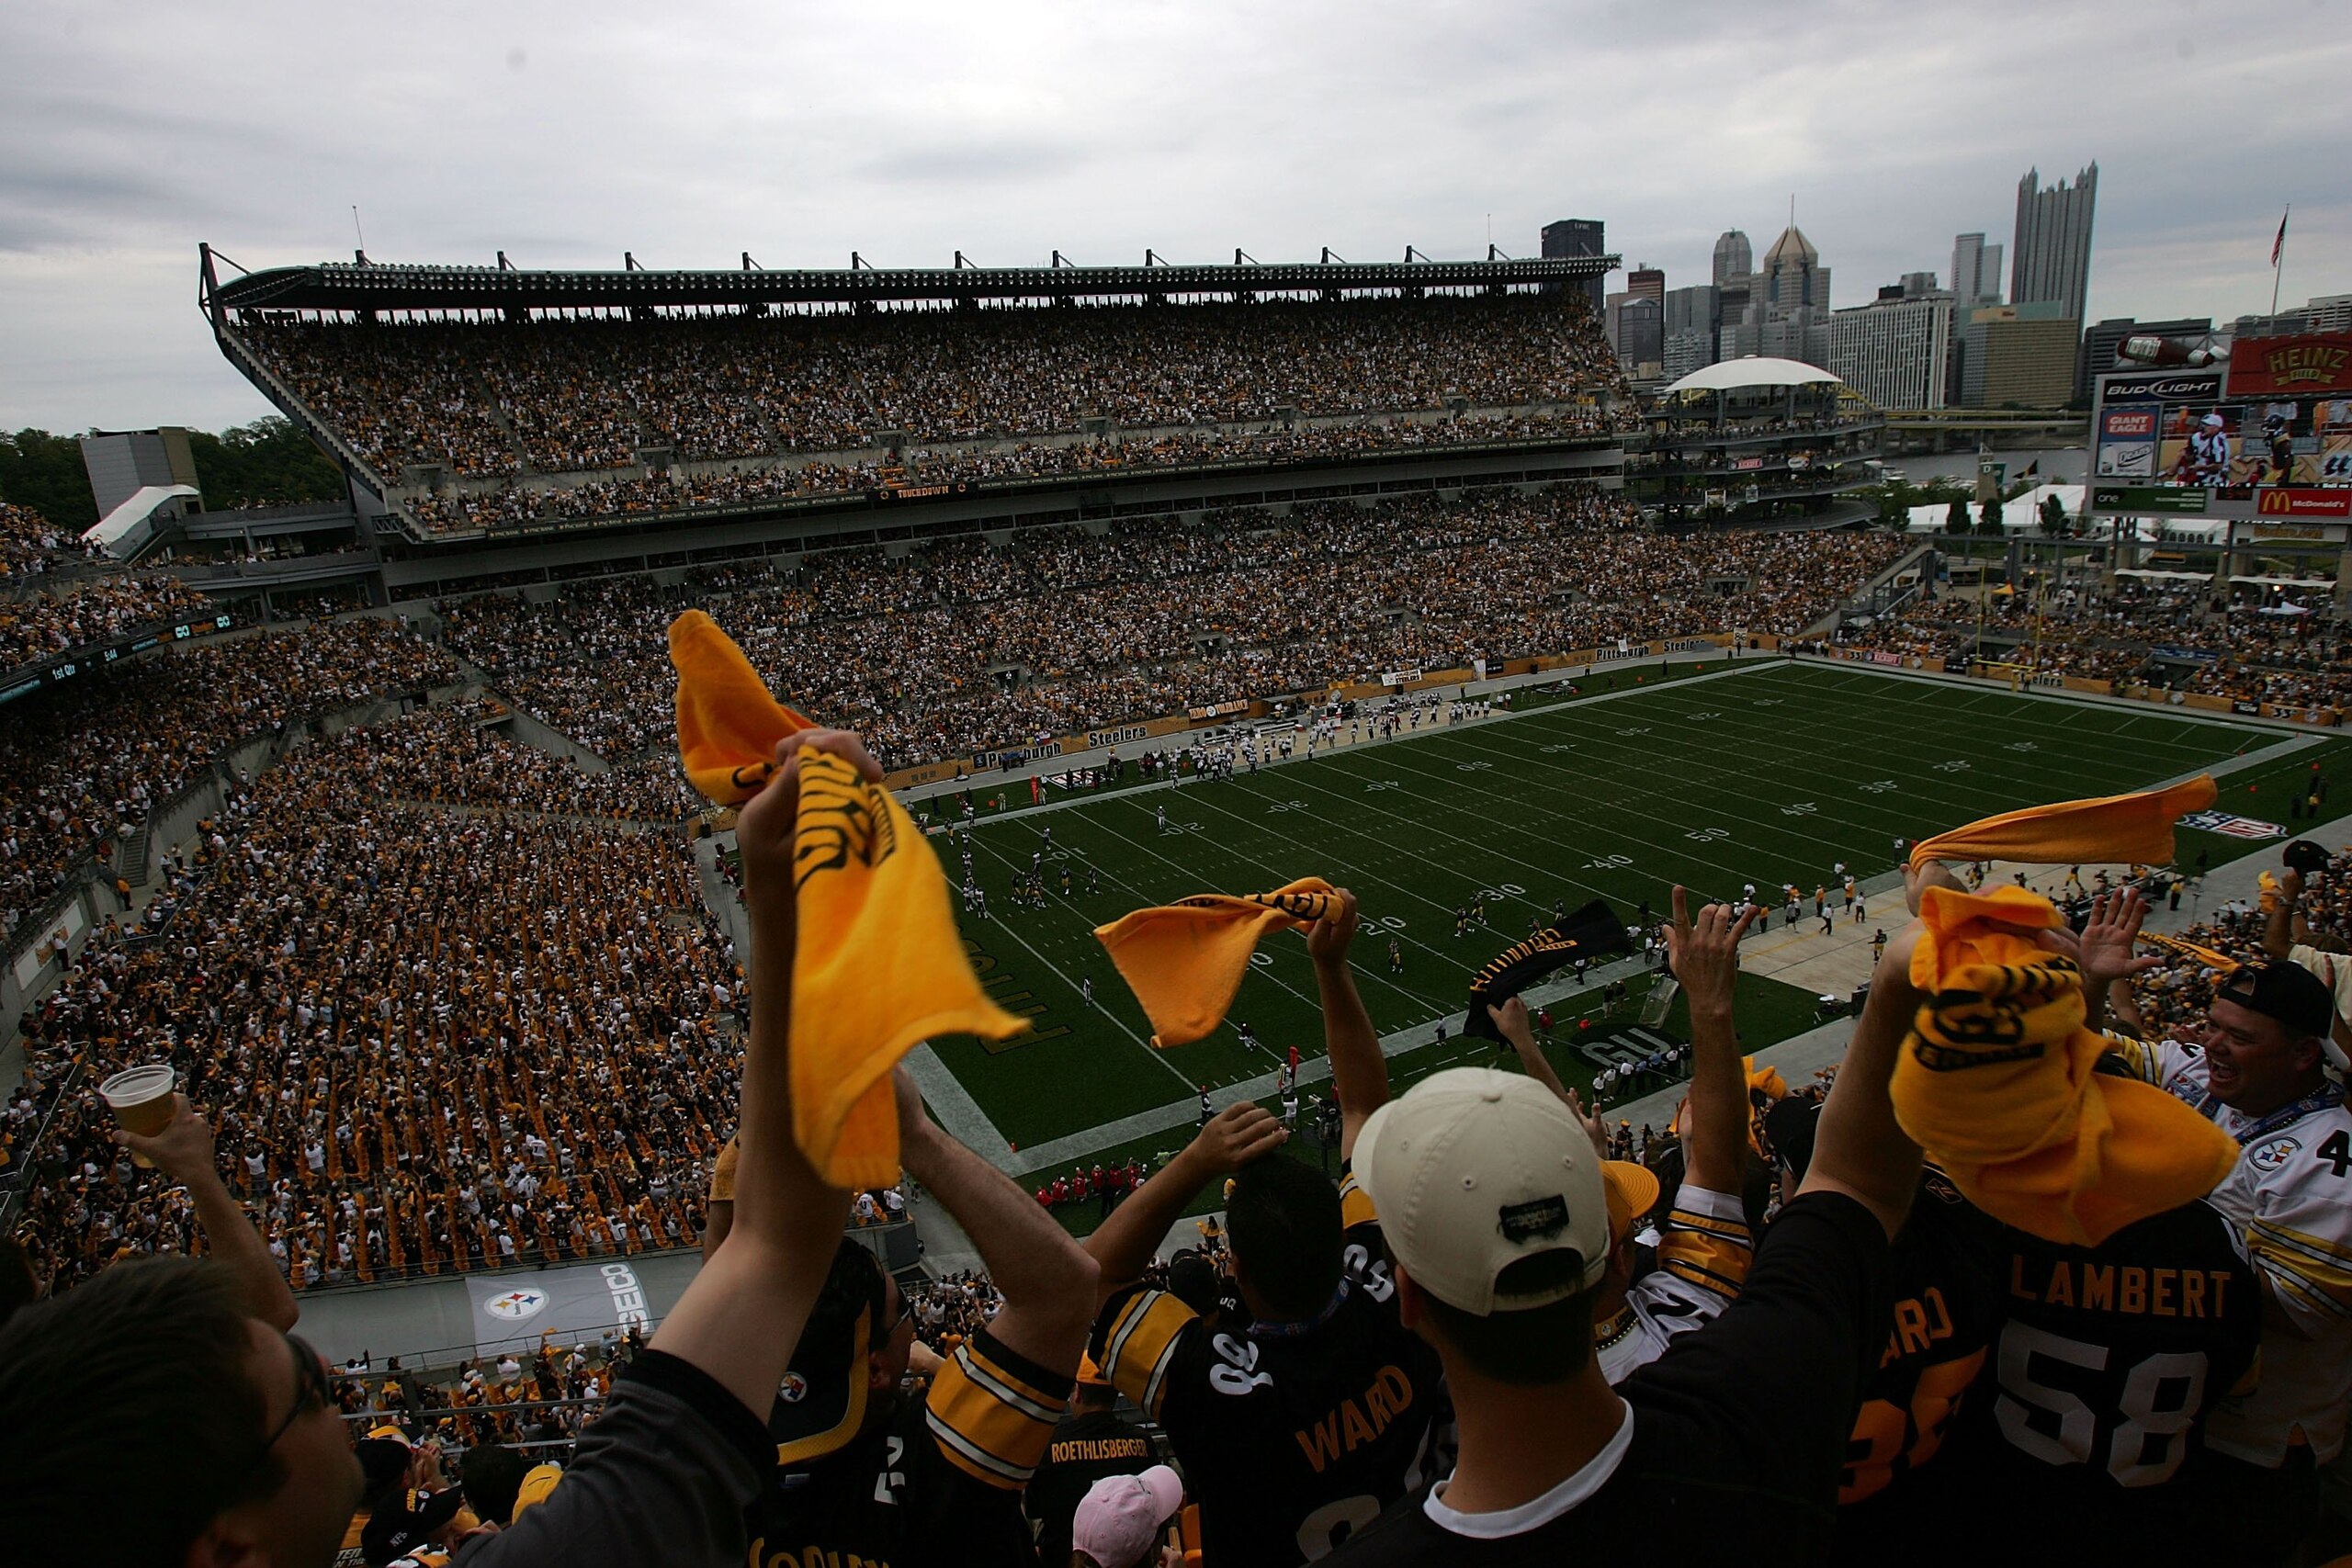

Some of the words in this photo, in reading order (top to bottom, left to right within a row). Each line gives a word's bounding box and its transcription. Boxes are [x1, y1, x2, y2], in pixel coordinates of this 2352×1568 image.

[2269, 346, 2349, 373] HEINZ
[2292, 369, 2317, 379] FIELD
[2107, 385, 2148, 396] BUD
[2156, 381, 2218, 393] LIGHT
[2109, 415, 2149, 424] GIANT
[2109, 423, 2148, 433] EAGLE
[897, 485, 949, 499] TOUCHDOWN
[2098, 493, 2120, 503] one
[2292, 500, 2345, 508] McDonald's
[104, 648, 118, 662] 5:44
[52, 667, 64, 681] 1st
[64, 663, 75, 677] Qtr
[988, 741, 1061, 768] Piburgh
[1089, 727, 1147, 748] Steelers
[1165, 821, 1205, 836] 20
[1684, 828, 1730, 842] 50
[1593, 853, 1634, 870] 40
[1477, 883, 1526, 902] 30
[1357, 915, 1408, 937] 20
[2009, 1252, 2233, 1319] LAMBERT
[600, 1264, 650, 1337] GEICO
[1993, 1317, 2211, 1489] 58
[1294, 1364, 1414, 1474] WARD
[1050, 1438, 1149, 1464] ROETHLISBERGER
